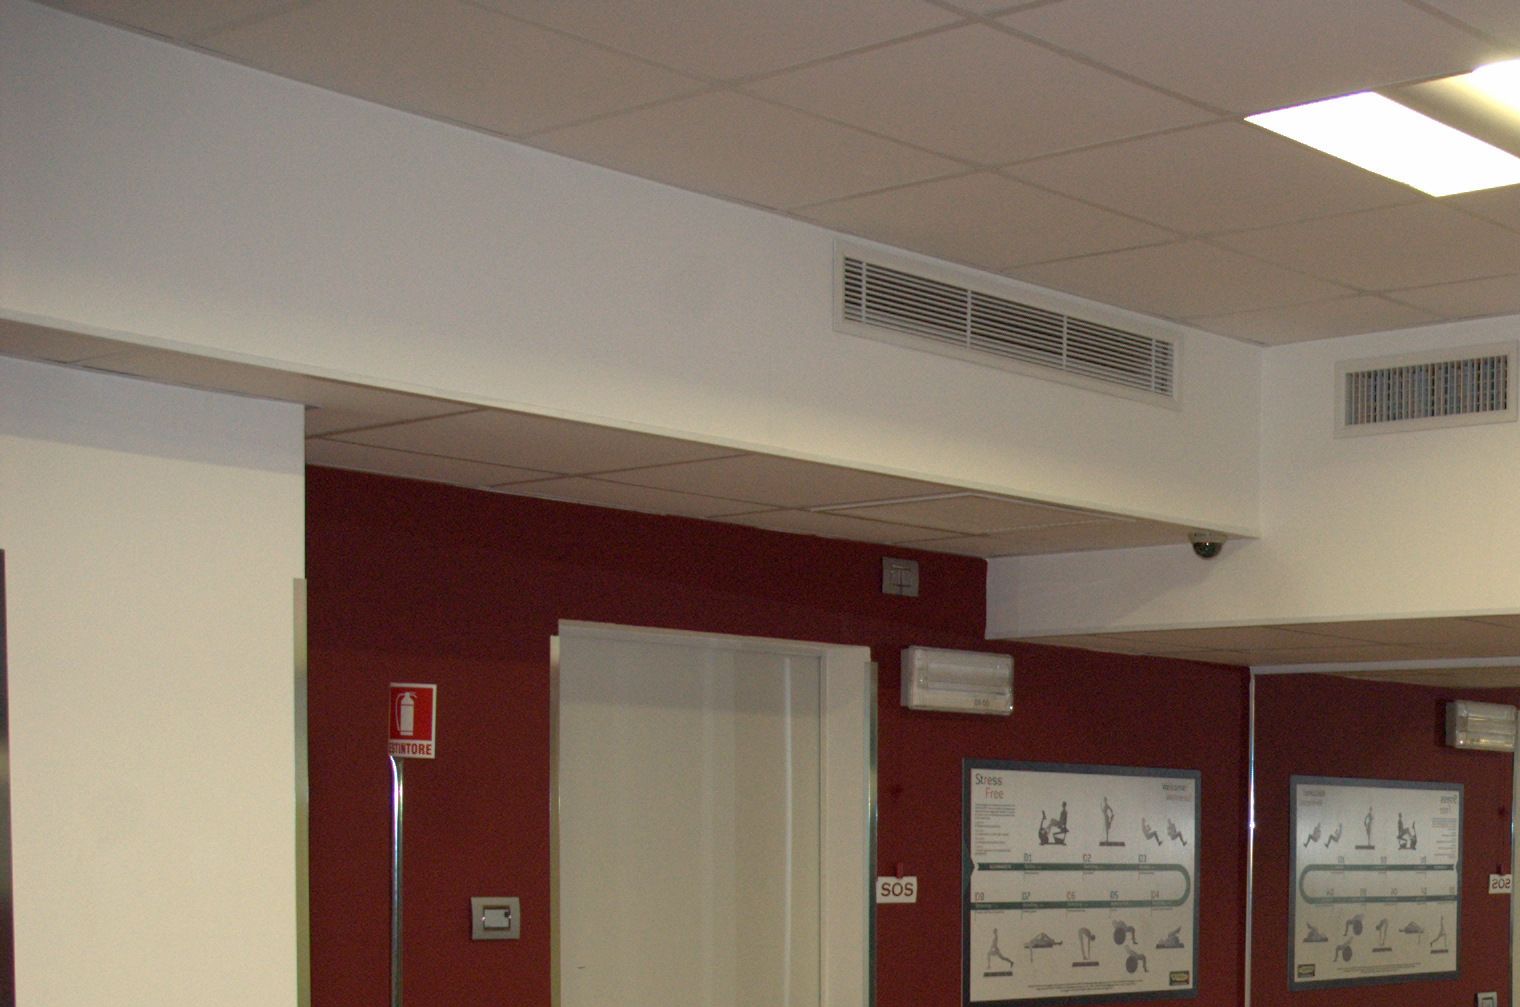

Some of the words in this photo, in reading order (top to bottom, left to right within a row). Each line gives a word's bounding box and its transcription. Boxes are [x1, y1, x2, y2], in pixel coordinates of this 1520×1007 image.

[389, 742, 432, 755] ESTINTORE
[975, 773, 1002, 786] Stress
[986, 787, 1004, 799] Free
[881, 882, 914, 897] SOS
